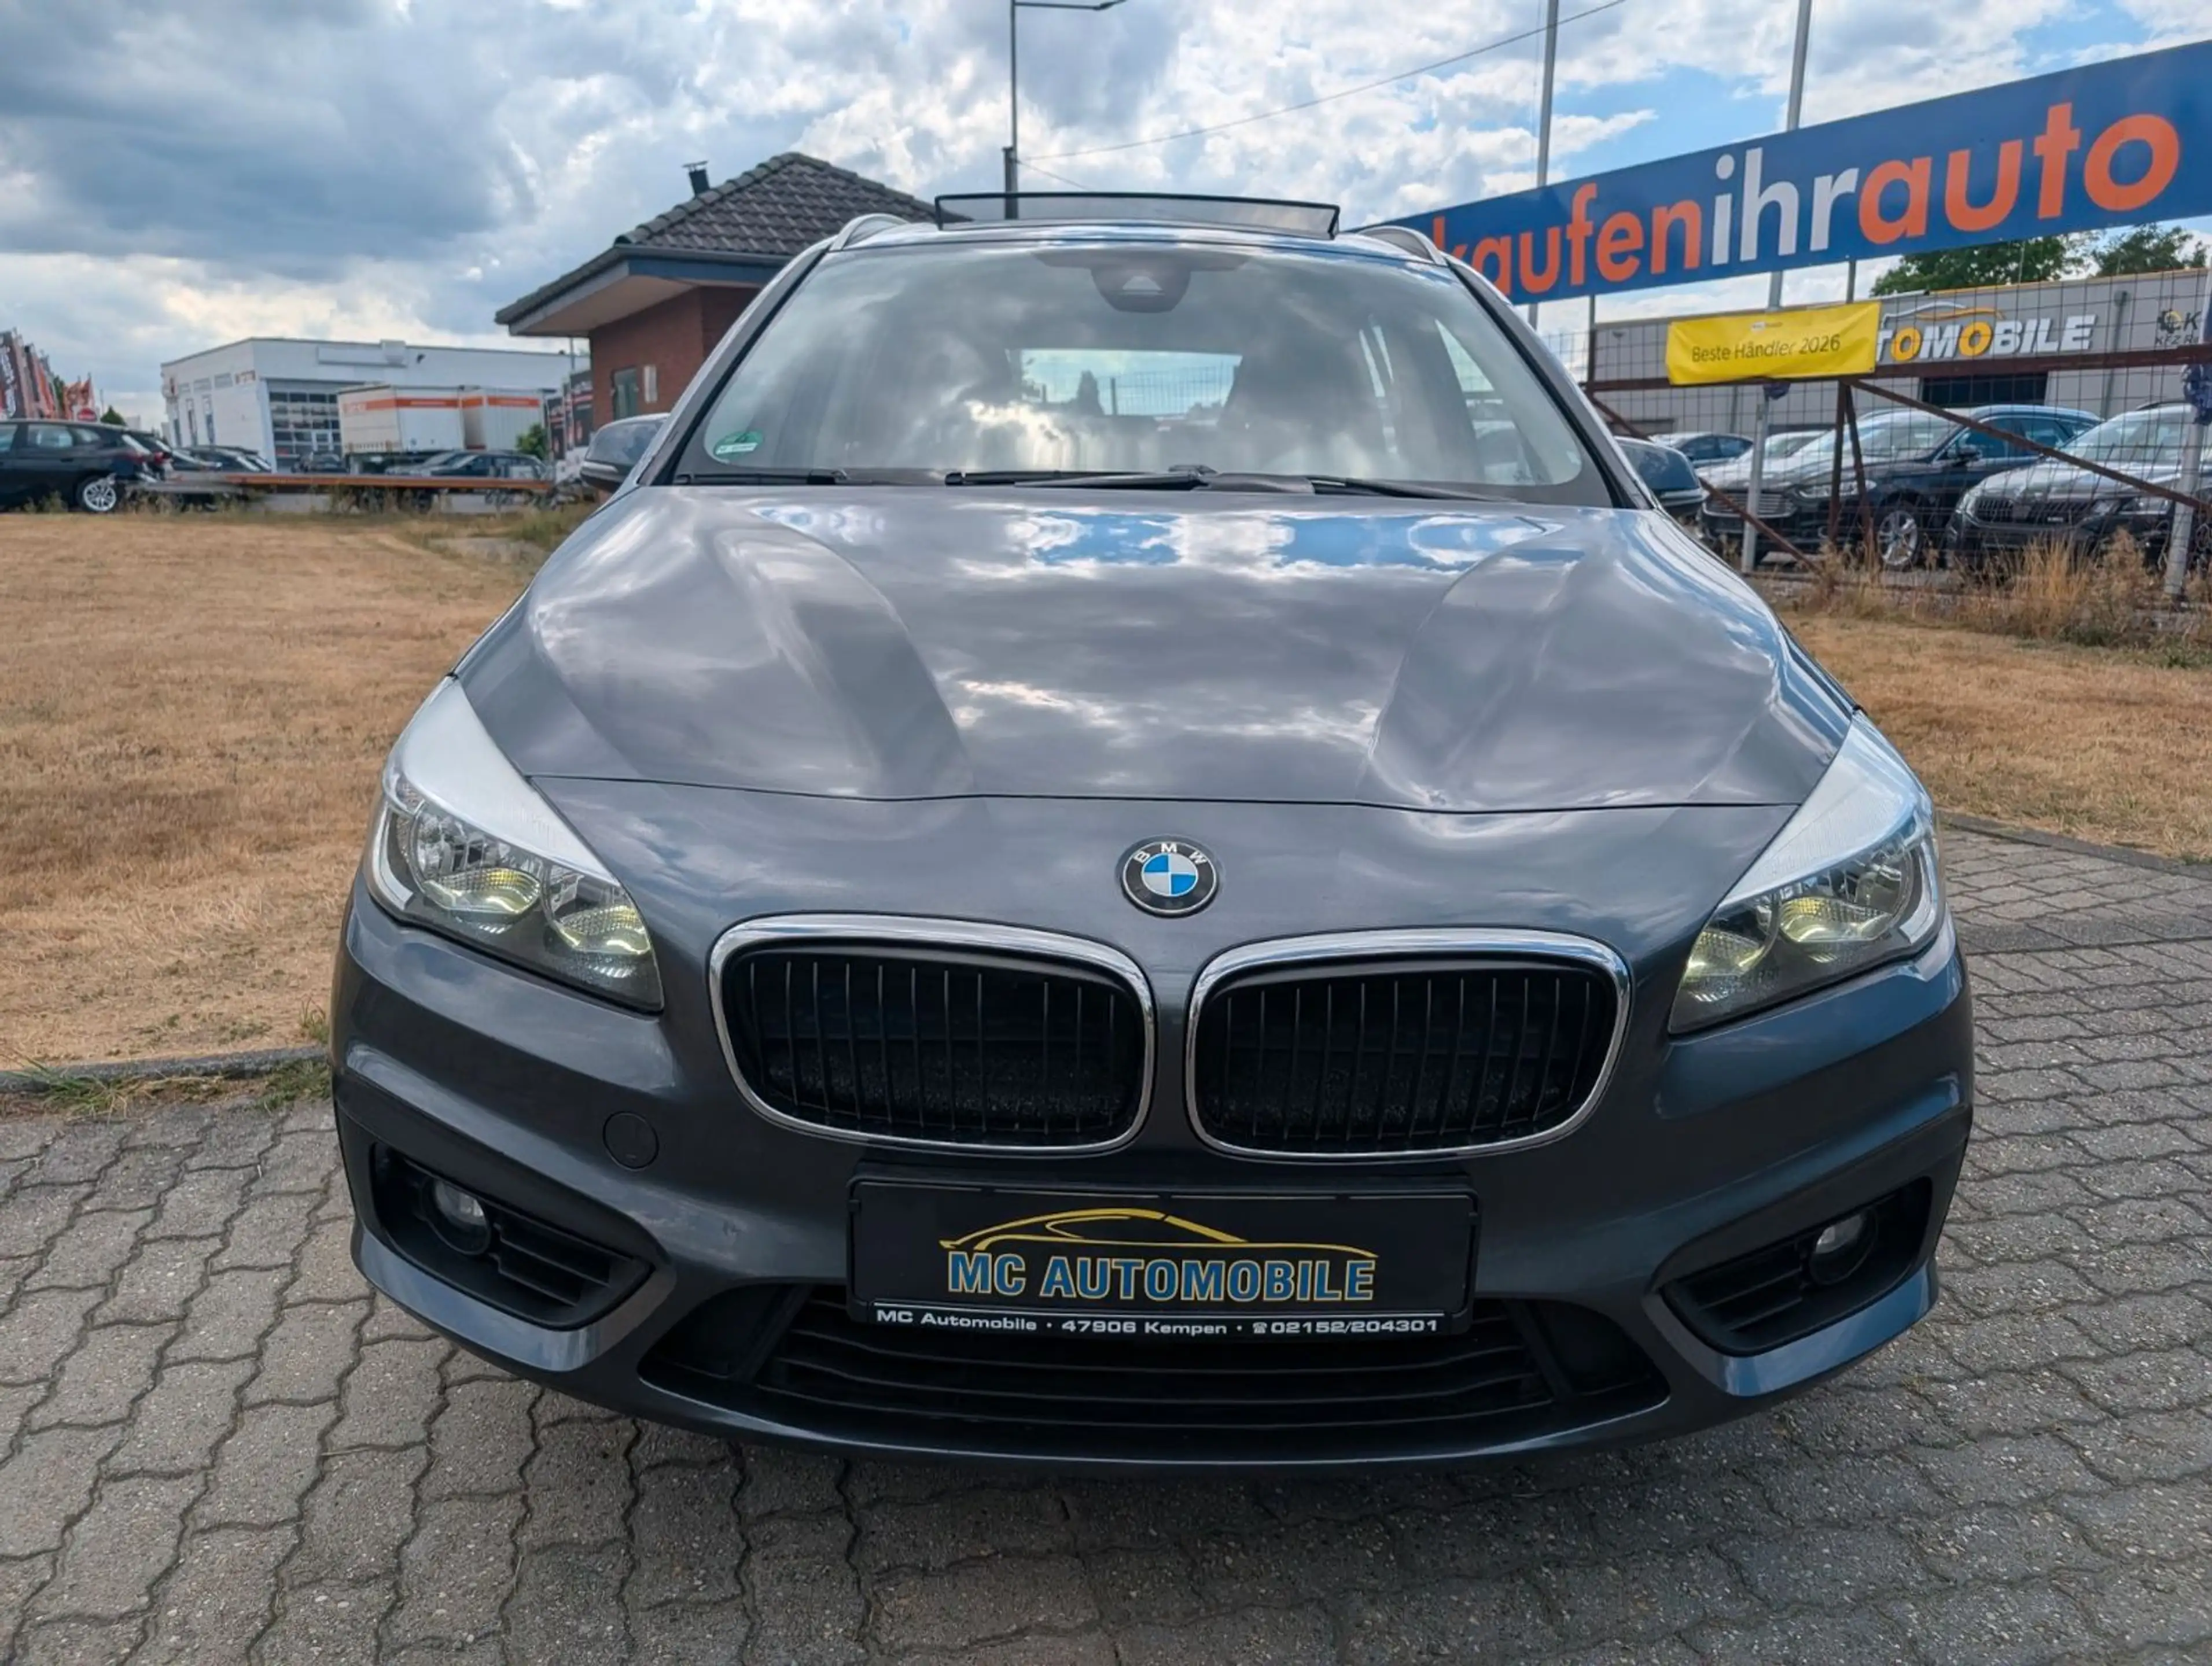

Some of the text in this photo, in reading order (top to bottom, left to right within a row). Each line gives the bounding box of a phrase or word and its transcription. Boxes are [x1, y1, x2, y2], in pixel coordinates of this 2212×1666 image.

[1691, 334, 1841, 363] Beste Händler 2026
[1133, 843, 1207, 865] BMW
[948, 1251, 1376, 1302] MC AUTOMOBILE
[877, 1310, 913, 1323] MC
[921, 1312, 1037, 1330] Automobile
[1062, 1320, 1136, 1333] 47906
[1144, 1322, 1227, 1337] Kempen
